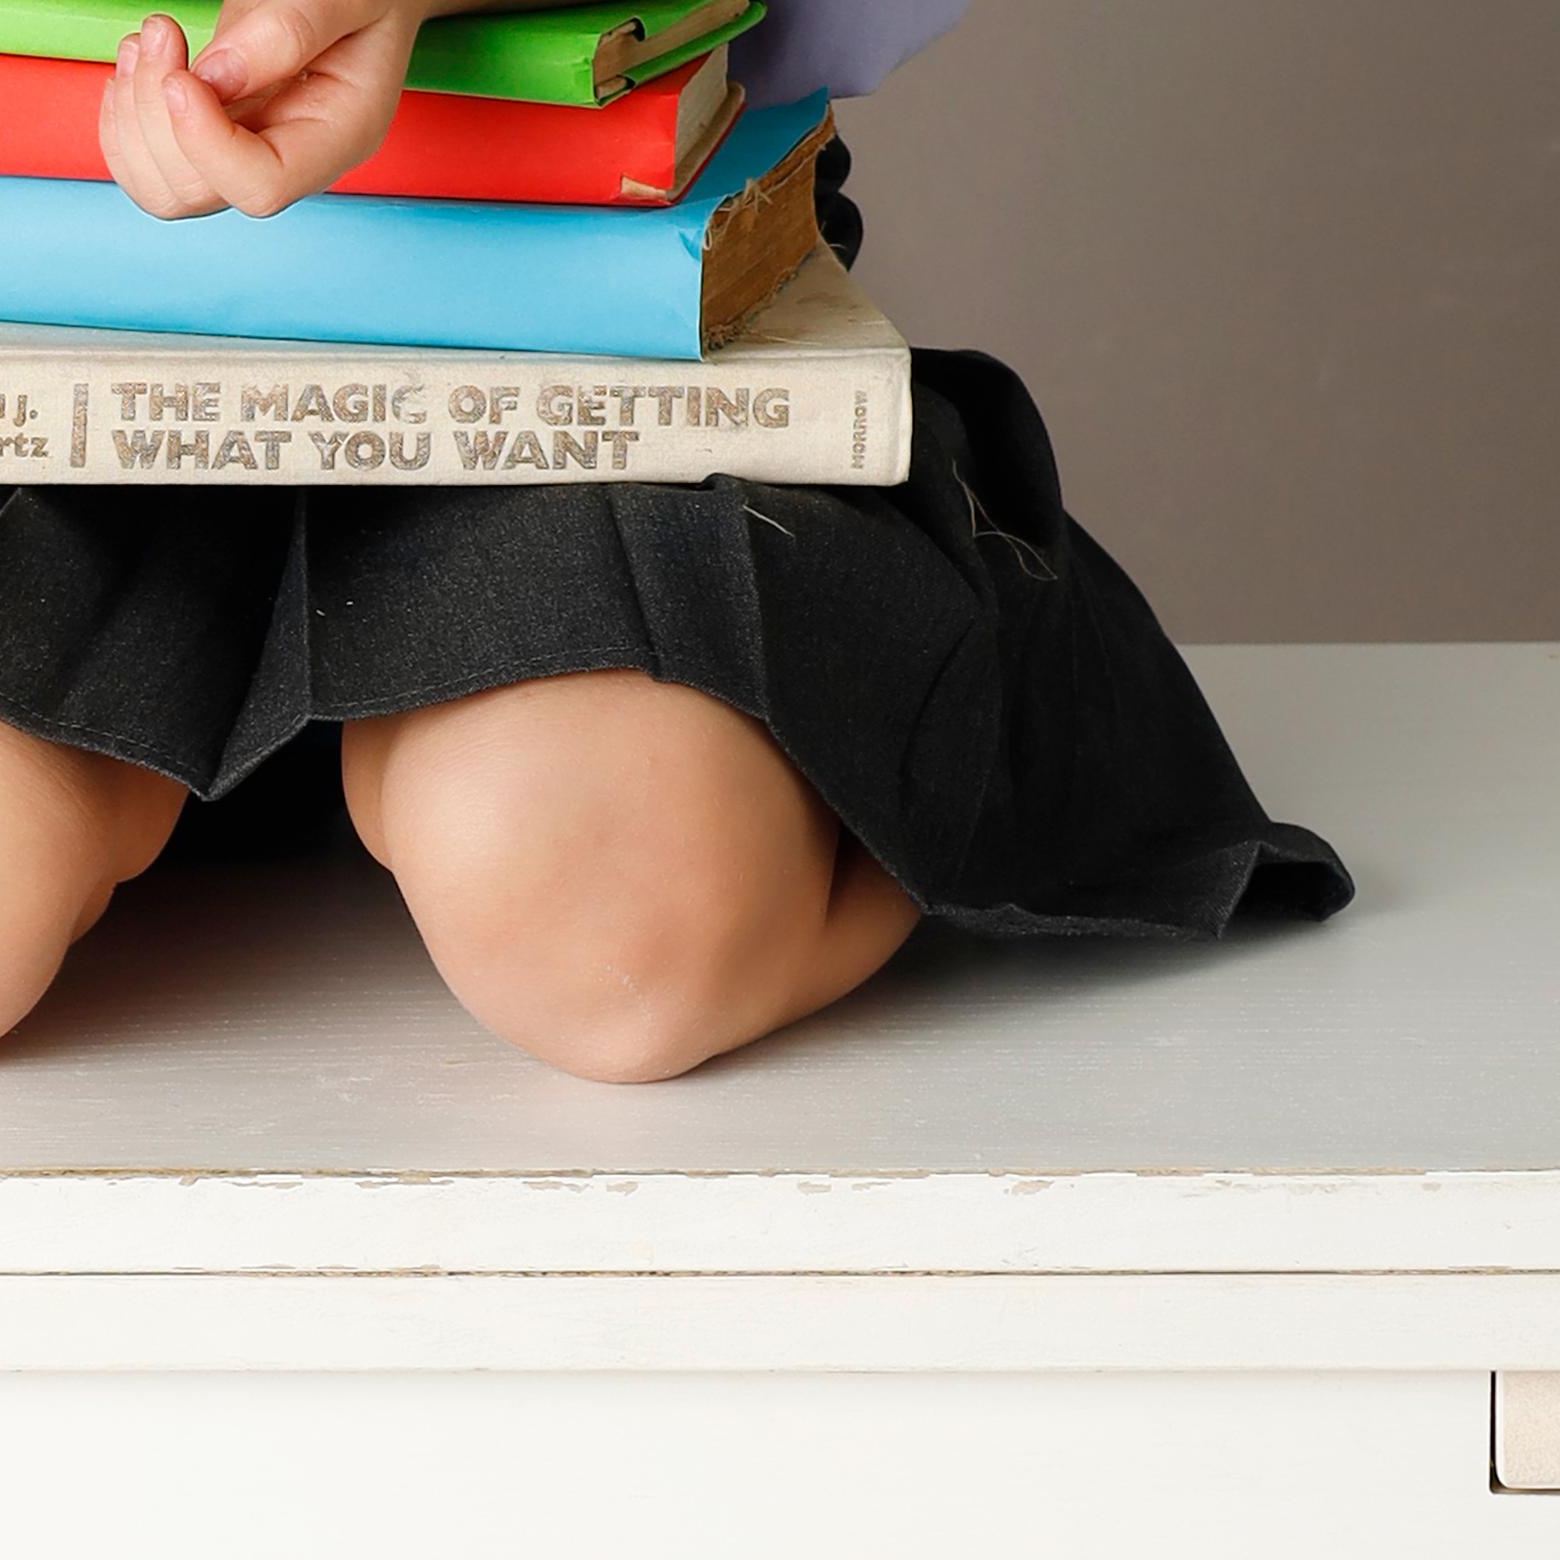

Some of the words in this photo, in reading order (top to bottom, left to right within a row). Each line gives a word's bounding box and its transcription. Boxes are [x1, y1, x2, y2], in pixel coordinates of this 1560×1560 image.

[111, 382, 221, 423] THE
[240, 382, 428, 424] MAGIC
[448, 384, 521, 425] OF
[536, 385, 791, 429] GETTING
[111, 429, 292, 471] WHAT
[308, 430, 431, 471] YOU
[454, 430, 640, 471] WANT
